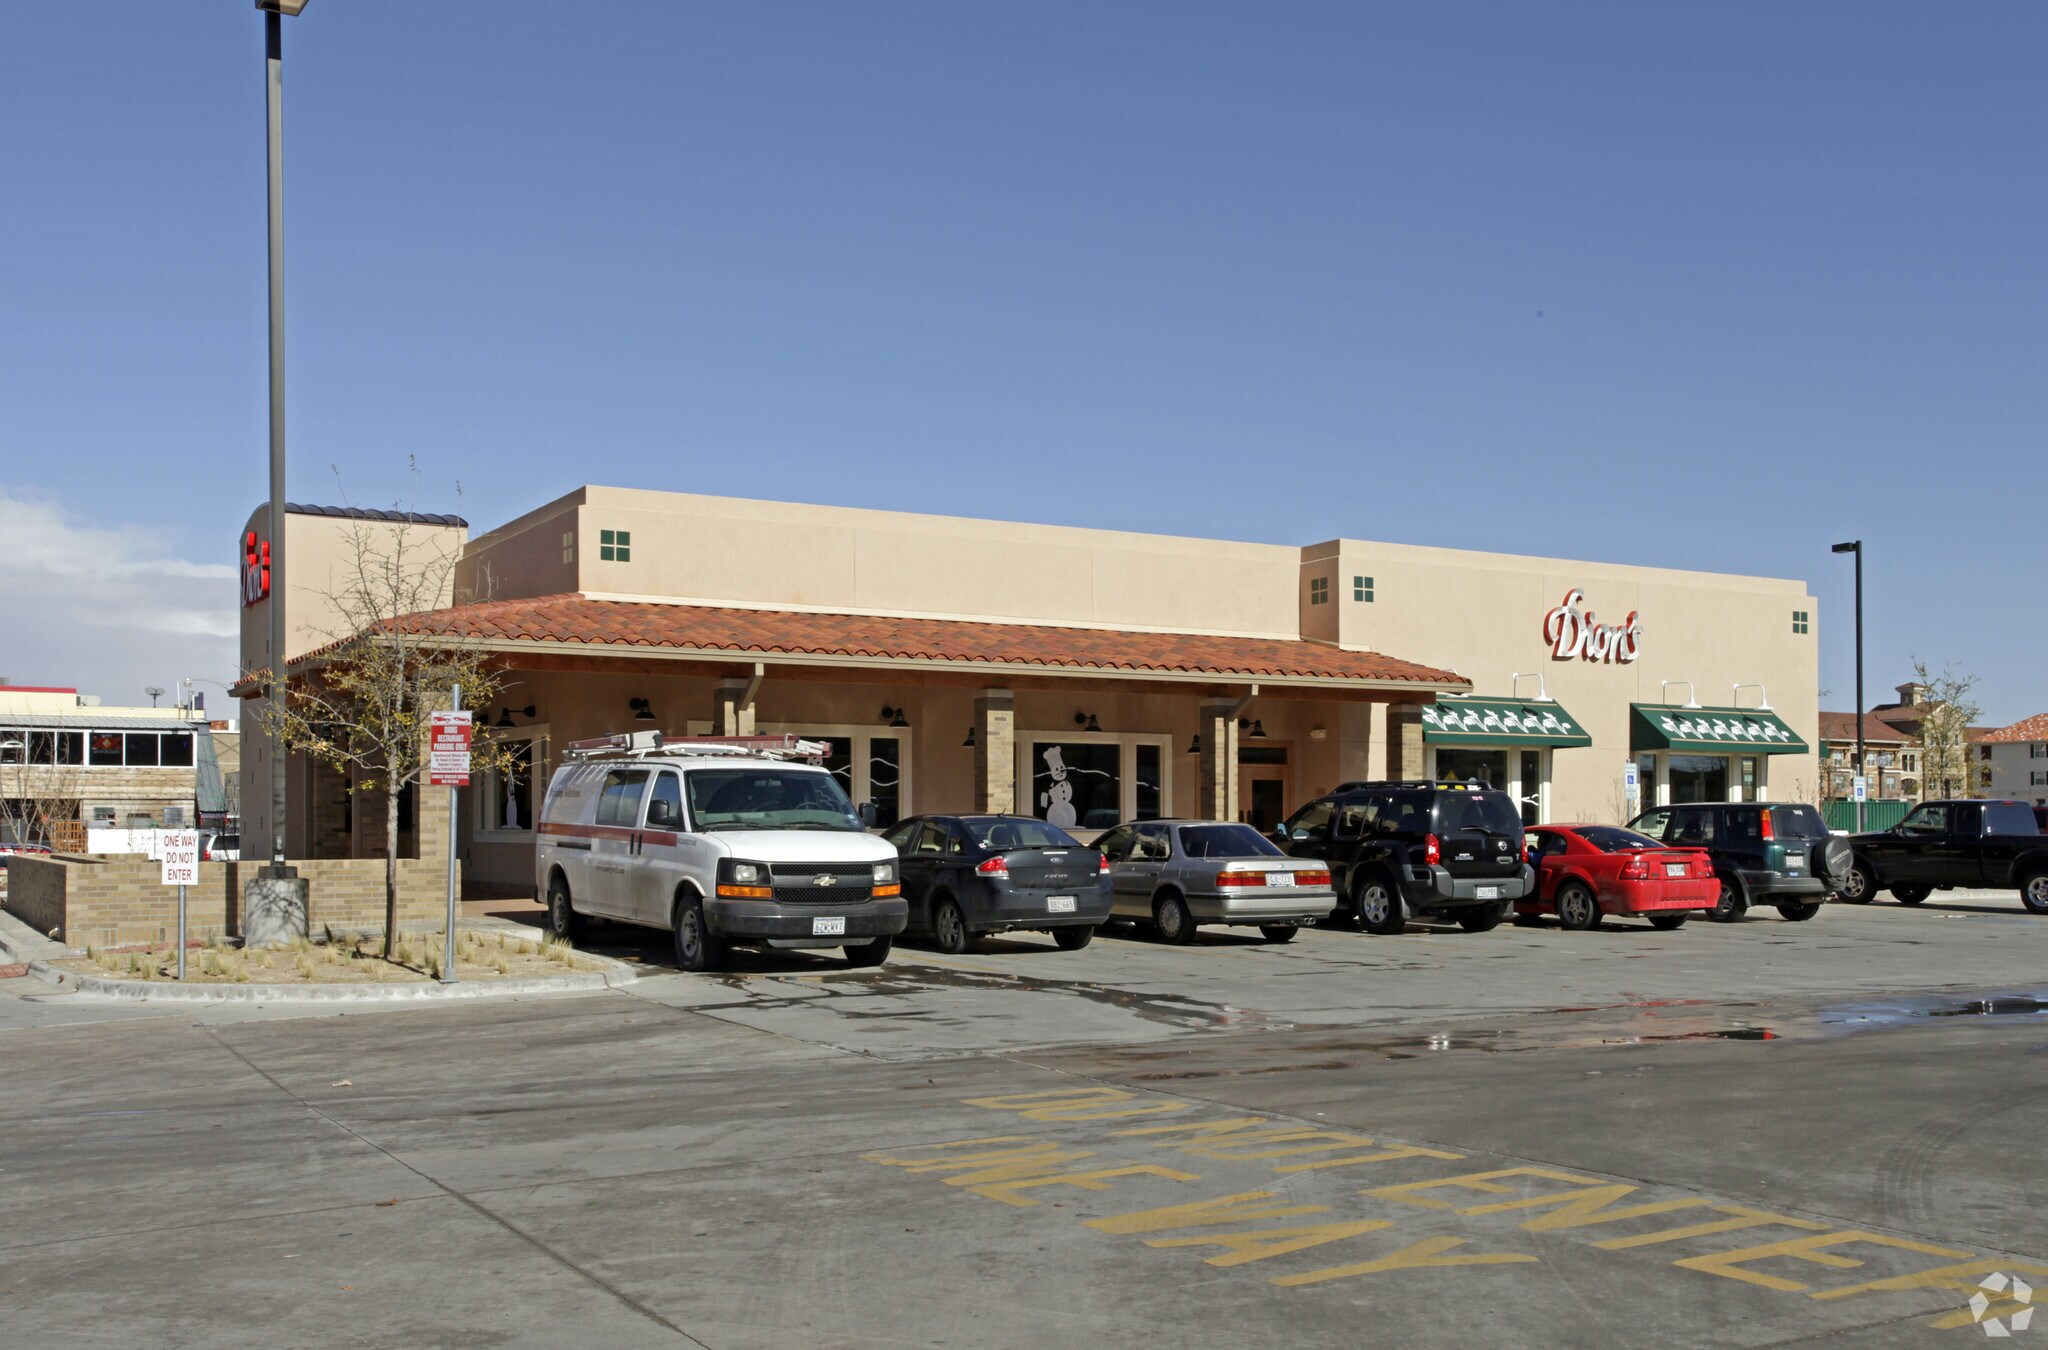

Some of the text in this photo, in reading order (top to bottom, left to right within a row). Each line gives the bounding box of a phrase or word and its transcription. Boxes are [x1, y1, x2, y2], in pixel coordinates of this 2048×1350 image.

[1543, 588, 1643, 663] Dion's
[437, 734, 464, 742] RESTAURANT
[433, 742, 468, 751] PARKING ONLY
[164, 835, 197, 847] ONE WAY
[166, 852, 194, 864] DO NOT
[168, 869, 192, 880] ENTER
[959, 1087, 1191, 1121] DO
[1110, 1117, 1468, 1173] NOT
[859, 1136, 1539, 1286] ONE WAY
